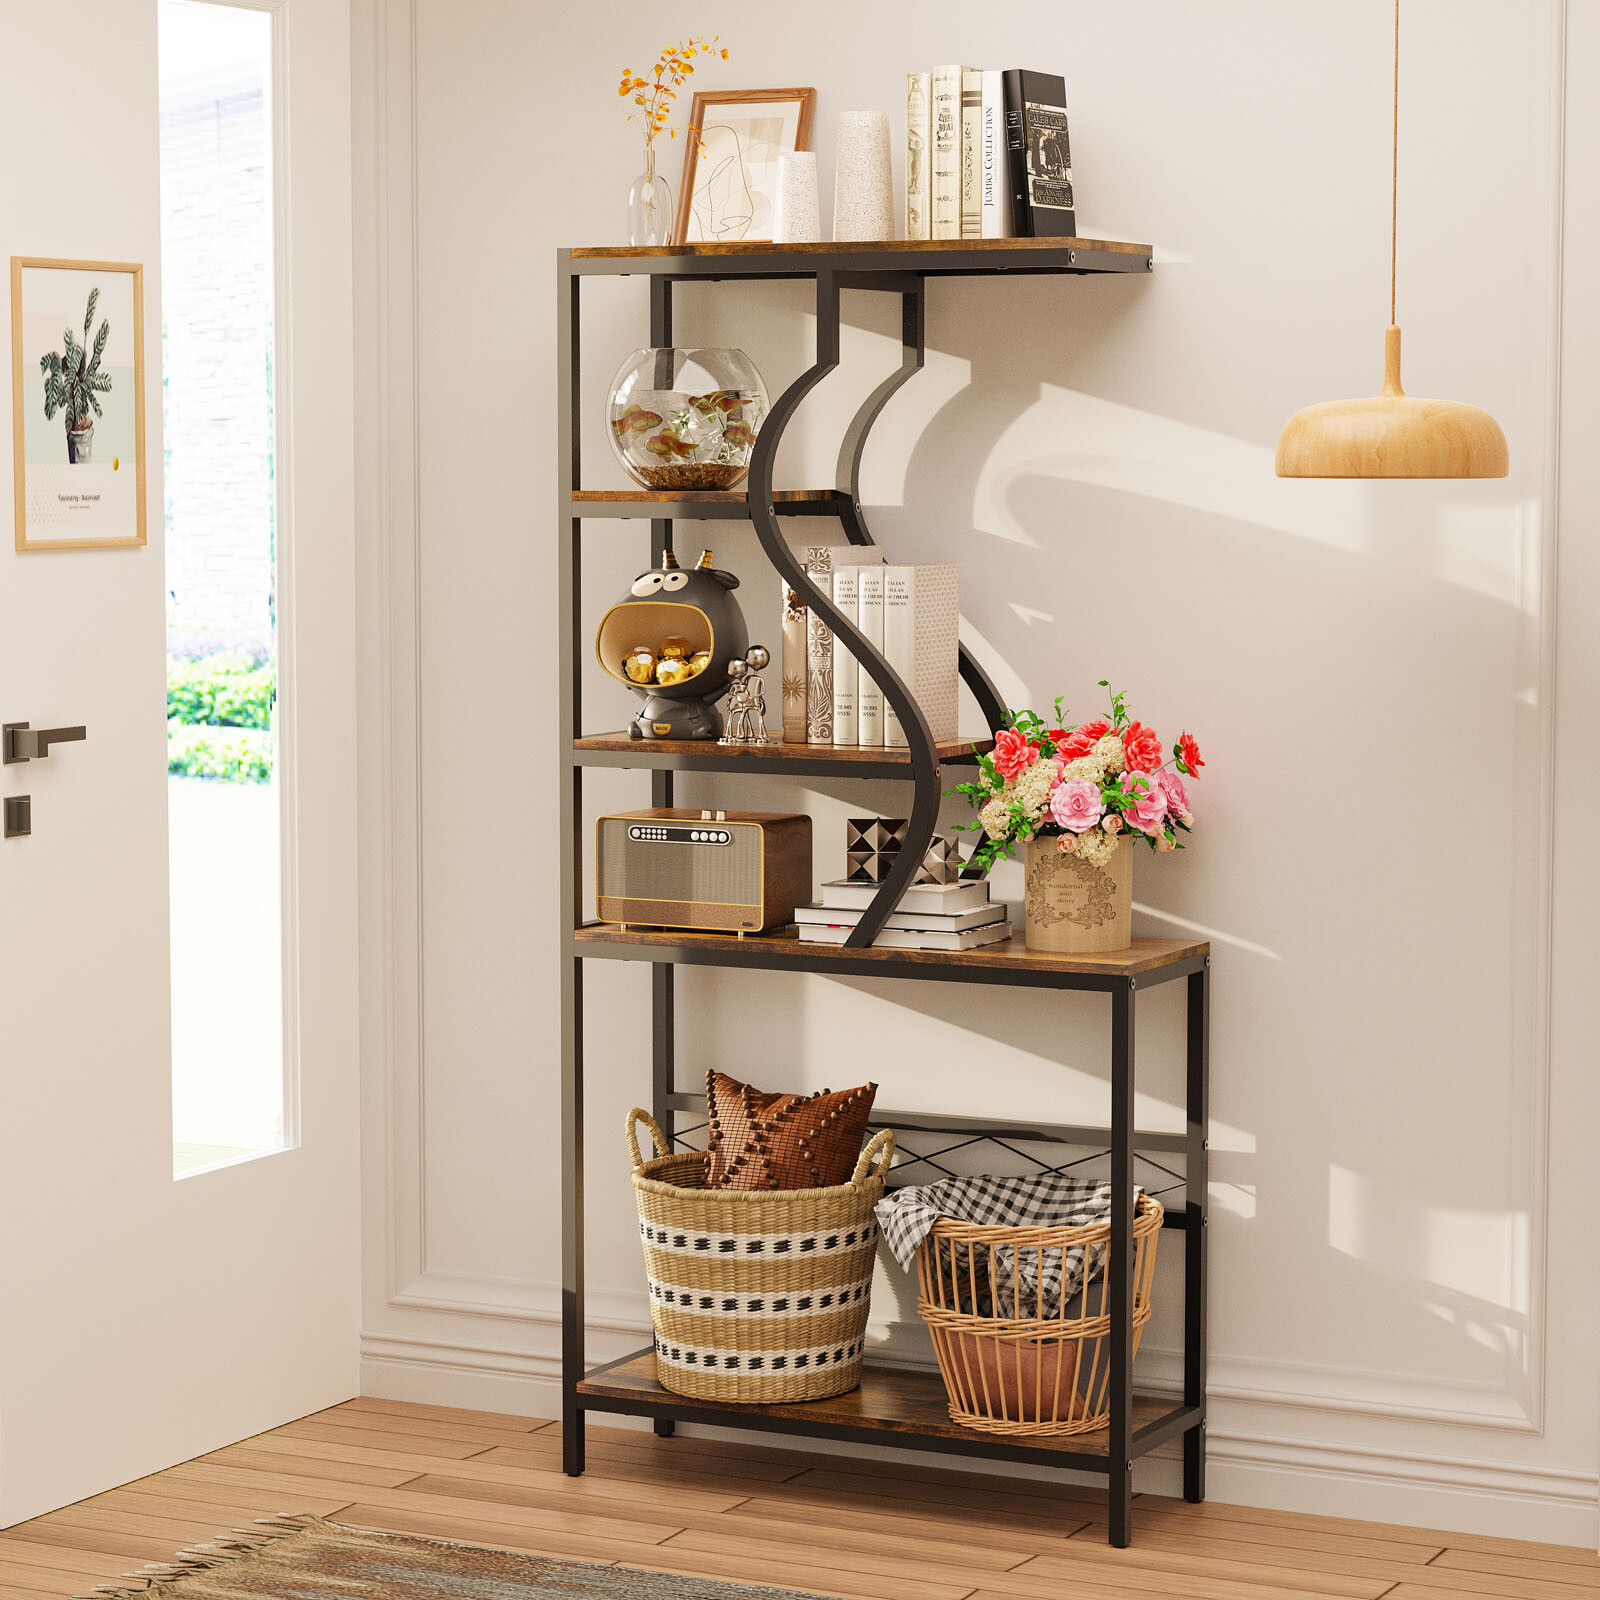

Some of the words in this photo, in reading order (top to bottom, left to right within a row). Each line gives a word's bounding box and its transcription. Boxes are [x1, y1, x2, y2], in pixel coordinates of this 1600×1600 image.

[1028, 113, 1049, 124] CALEB
[1050, 116, 1067, 127] CARR
[984, 106, 993, 170] COLLECTION
[984, 172, 995, 207] JUMBO
[1035, 194, 1072, 207] DARKNESS
